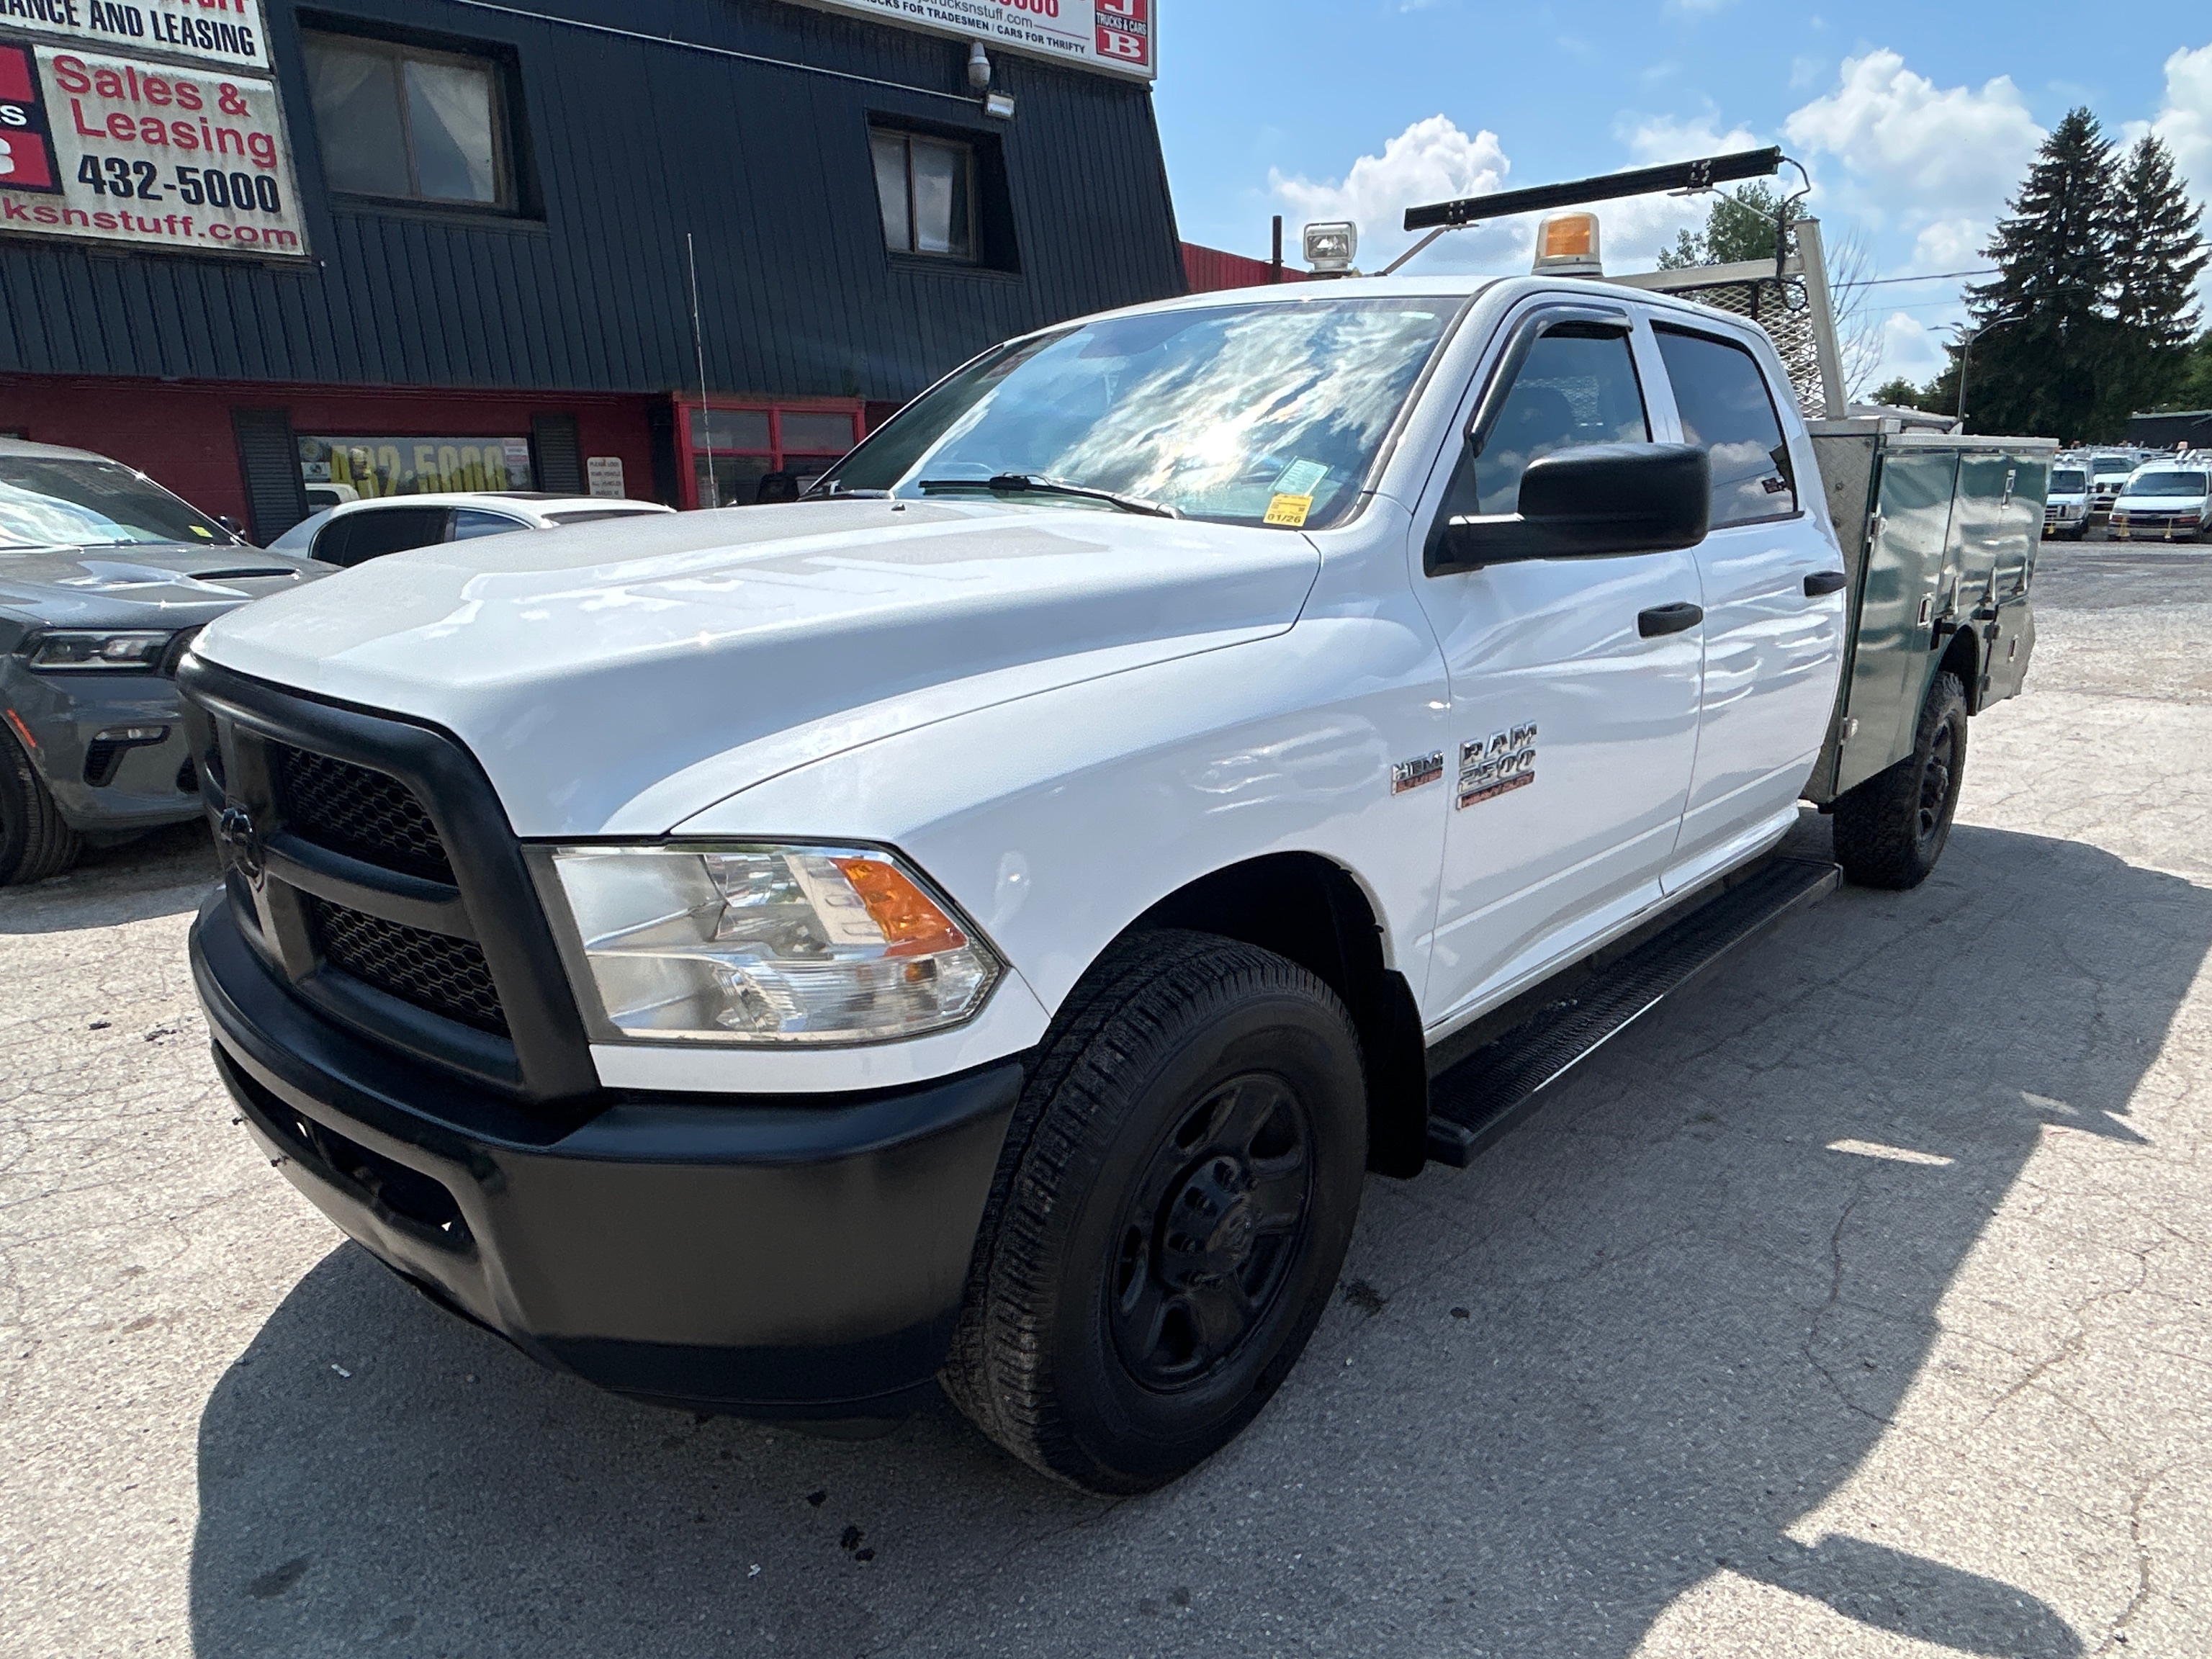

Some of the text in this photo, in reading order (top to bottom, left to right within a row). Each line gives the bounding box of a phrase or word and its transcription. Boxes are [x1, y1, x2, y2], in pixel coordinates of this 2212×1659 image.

[91, 1, 144, 37] AND
[150, 10, 256, 57] LEASING
[902, 2, 925, 16] FOR
[927, 7, 989, 31] TRADESMEN
[997, 25, 1023, 39] CARS
[1025, 30, 1045, 45] FOR
[1046, 37, 1085, 54] THRIFTY
[1096, 12, 1123, 30] TRUCKS
[1129, 20, 1146, 35] CARS
[1102, 30, 1141, 58] B
[53, 55, 251, 117] Sales &
[71, 98, 277, 168] Leasing
[77, 154, 282, 214] 432-5000
[1460, 720, 1537, 768] RAM
